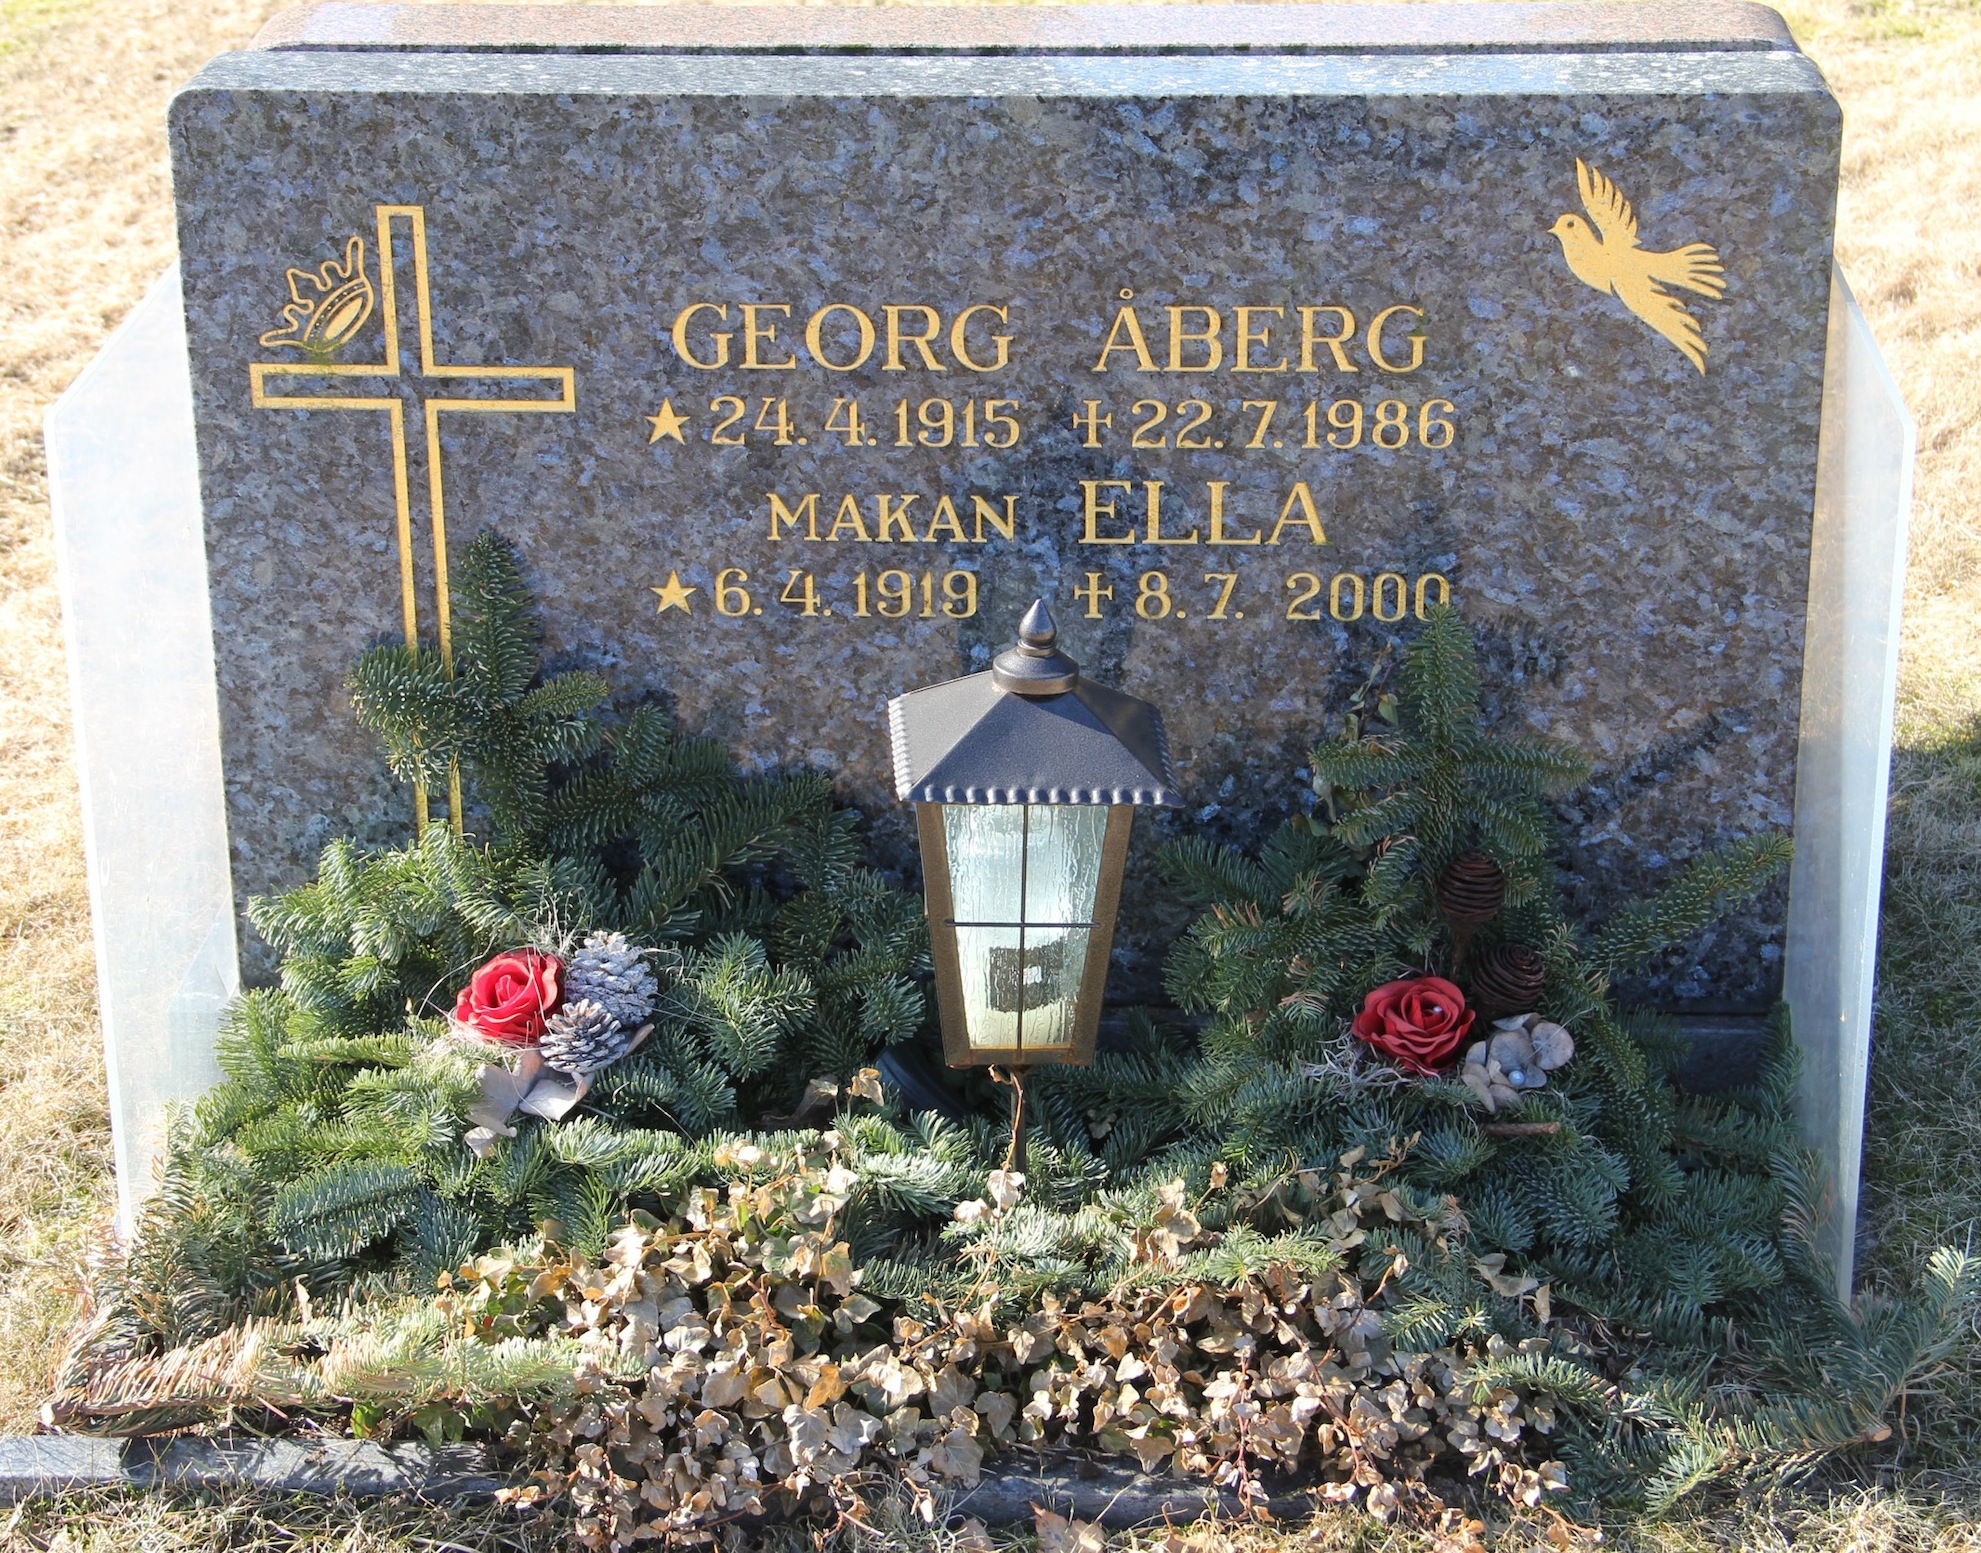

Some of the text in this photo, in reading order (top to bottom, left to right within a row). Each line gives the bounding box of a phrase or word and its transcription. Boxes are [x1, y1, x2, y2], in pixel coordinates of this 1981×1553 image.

[672, 288, 1428, 373] GEORG ÅBERG
[894, 398, 1020, 448] 1915
[1302, 400, 1455, 449] 1986
[766, 480, 1328, 546] MAKAN ELLA
[853, 570, 978, 618] 1919
[1286, 573, 1450, 621] 2000
